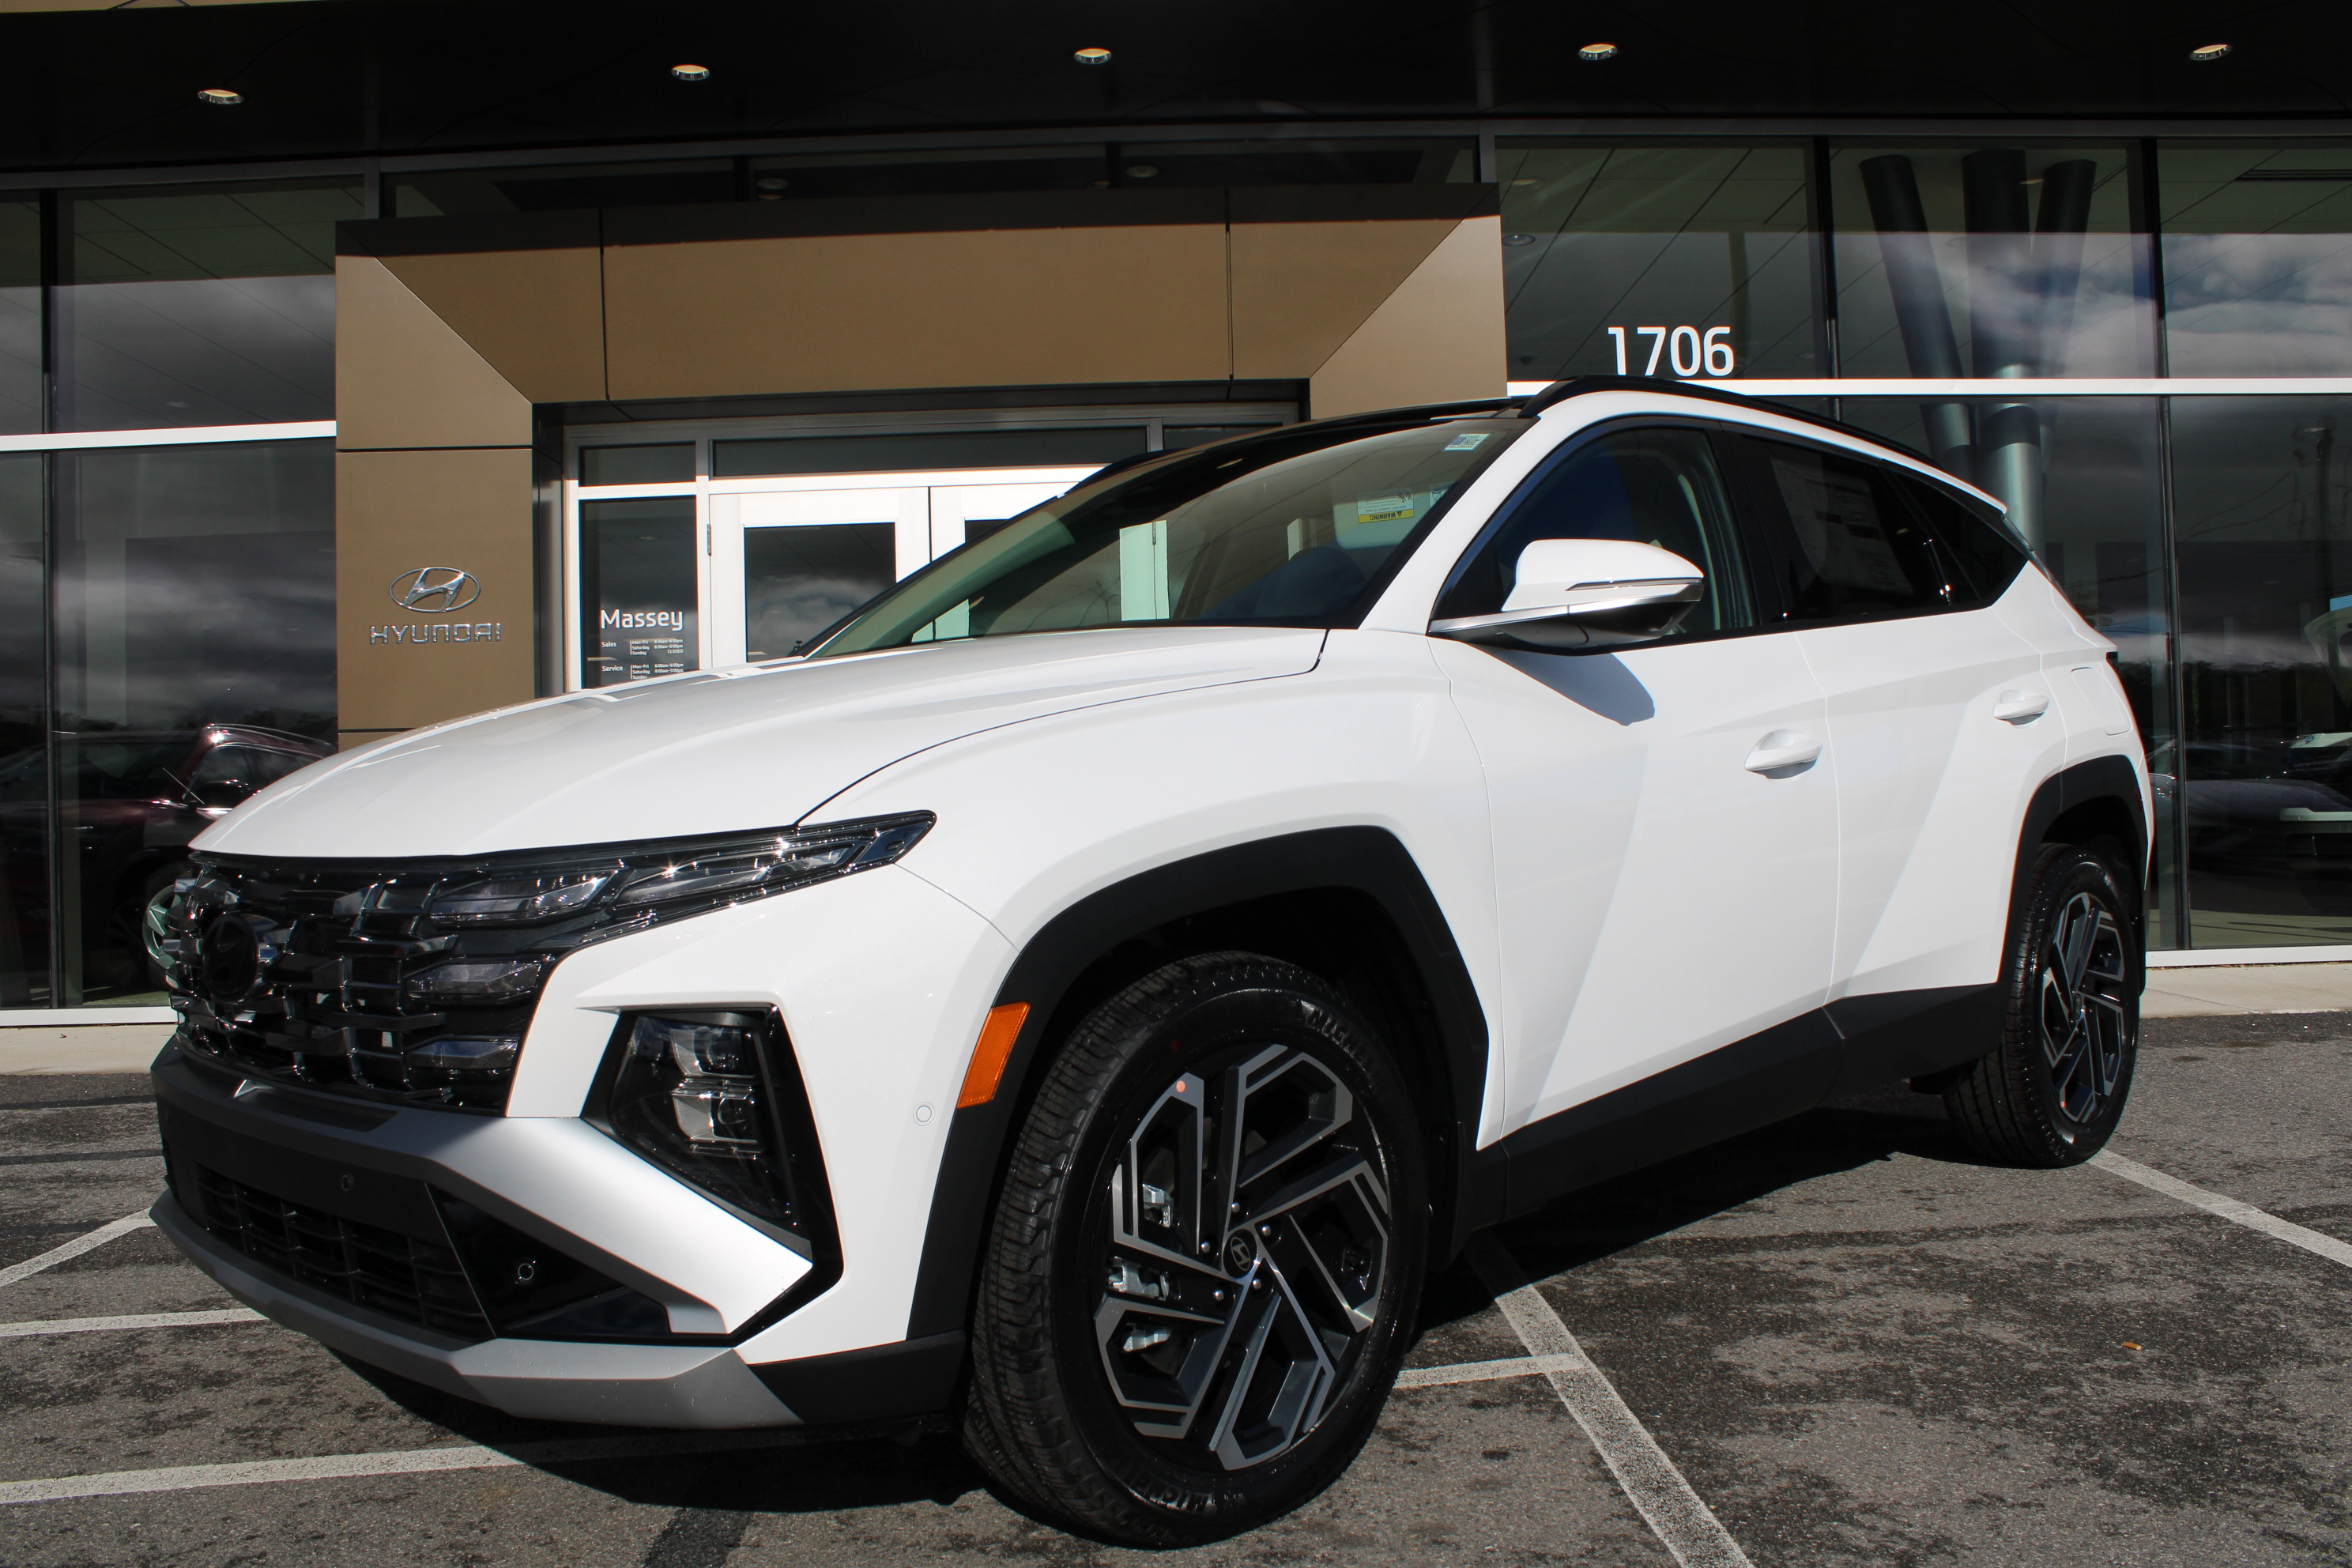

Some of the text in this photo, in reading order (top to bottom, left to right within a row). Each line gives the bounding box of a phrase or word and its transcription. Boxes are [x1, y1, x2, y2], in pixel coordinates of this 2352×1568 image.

[1608, 326, 1735, 377] 1706
[1369, 512, 1396, 521] WARNING
[601, 609, 684, 631] Massey
[370, 622, 502, 645] HYUNDAI
